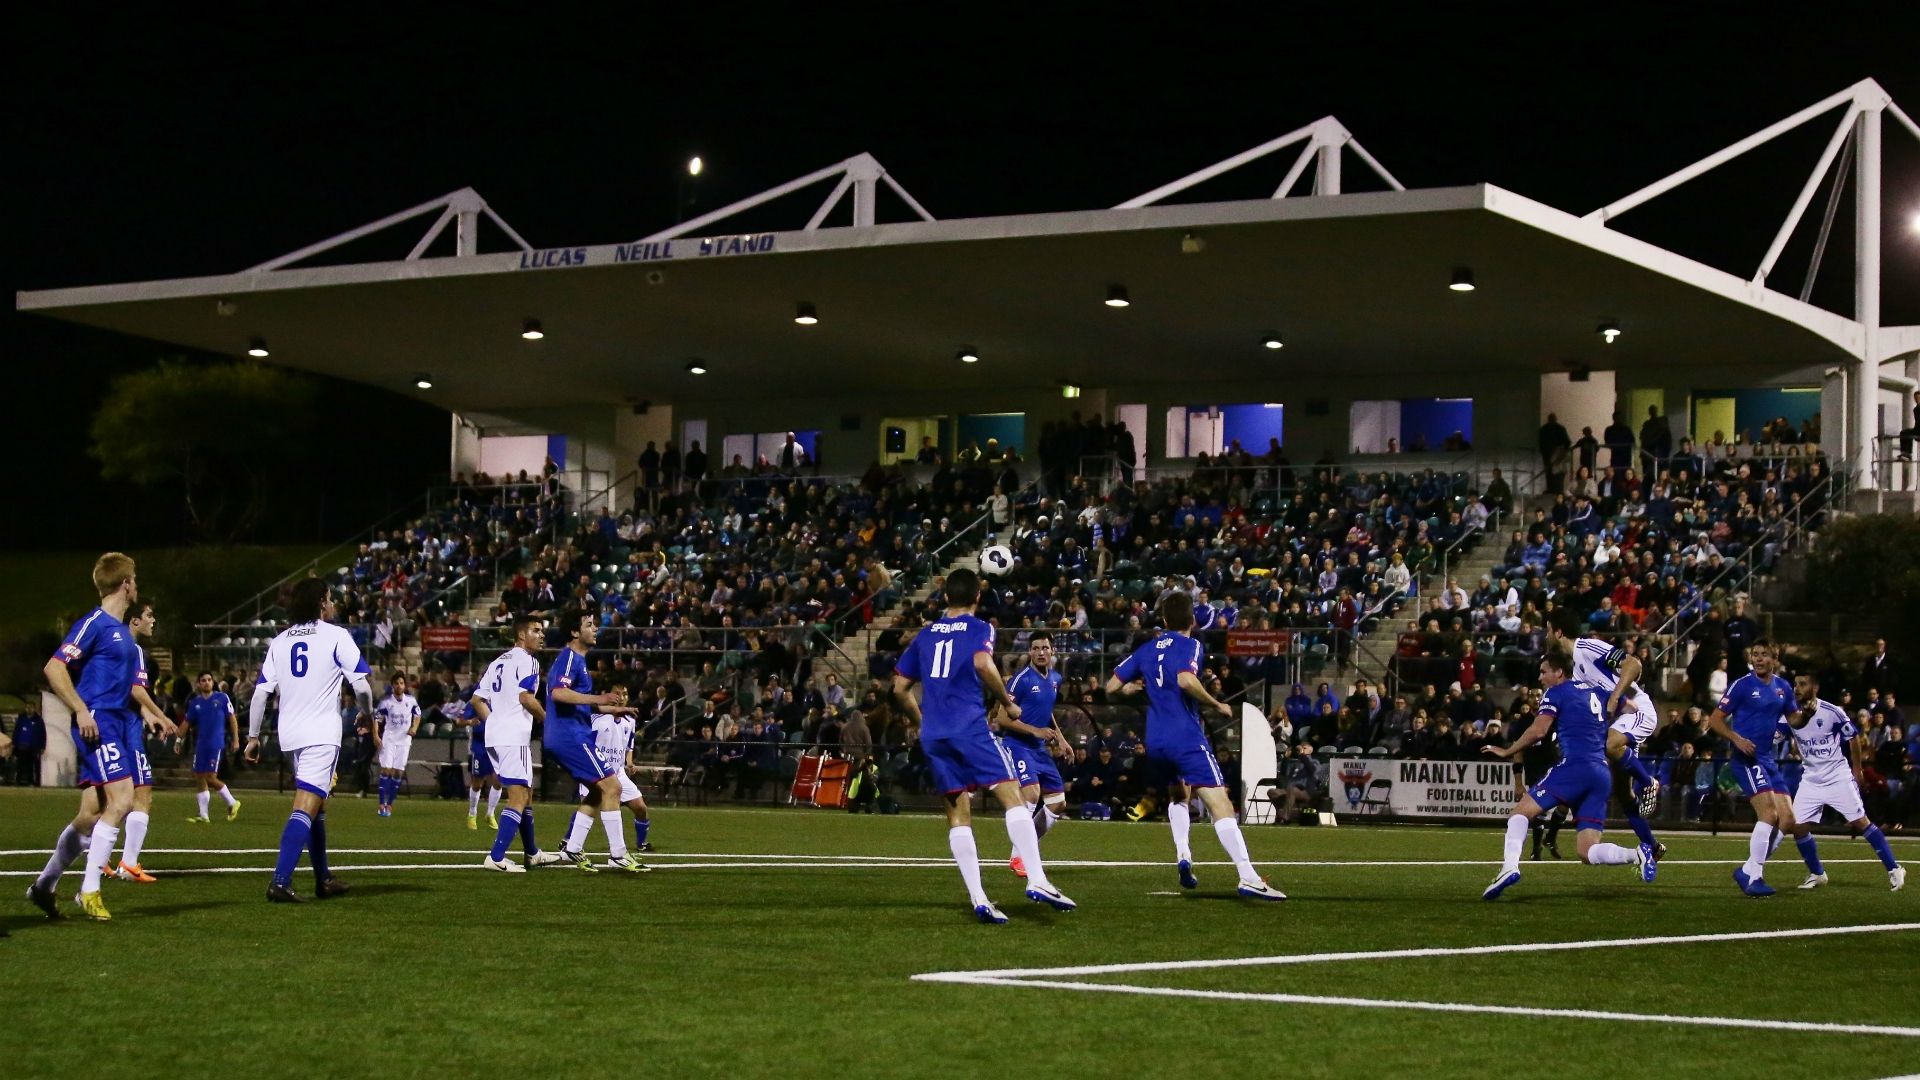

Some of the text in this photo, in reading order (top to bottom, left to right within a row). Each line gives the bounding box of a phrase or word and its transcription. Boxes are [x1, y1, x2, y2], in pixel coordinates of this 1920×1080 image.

[520, 235, 775, 269] LUCAS NEILL STAND
[291, 642, 308, 677] 6
[930, 638, 954, 678] 11
[492, 664, 504, 692] 3
[1591, 693, 1604, 722] 4
[101, 743, 120, 762] 15
[595, 747, 606, 762] 6
[141, 754, 151, 771] 2
[474, 759, 480, 770] 8
[1018, 760, 1027, 773] 9
[1343, 761, 1367, 770] MANLY
[1400, 762, 1511, 786] MANLY UNI
[1753, 765, 1764, 780] 2
[1427, 788, 1487, 802] FOOTBALL
